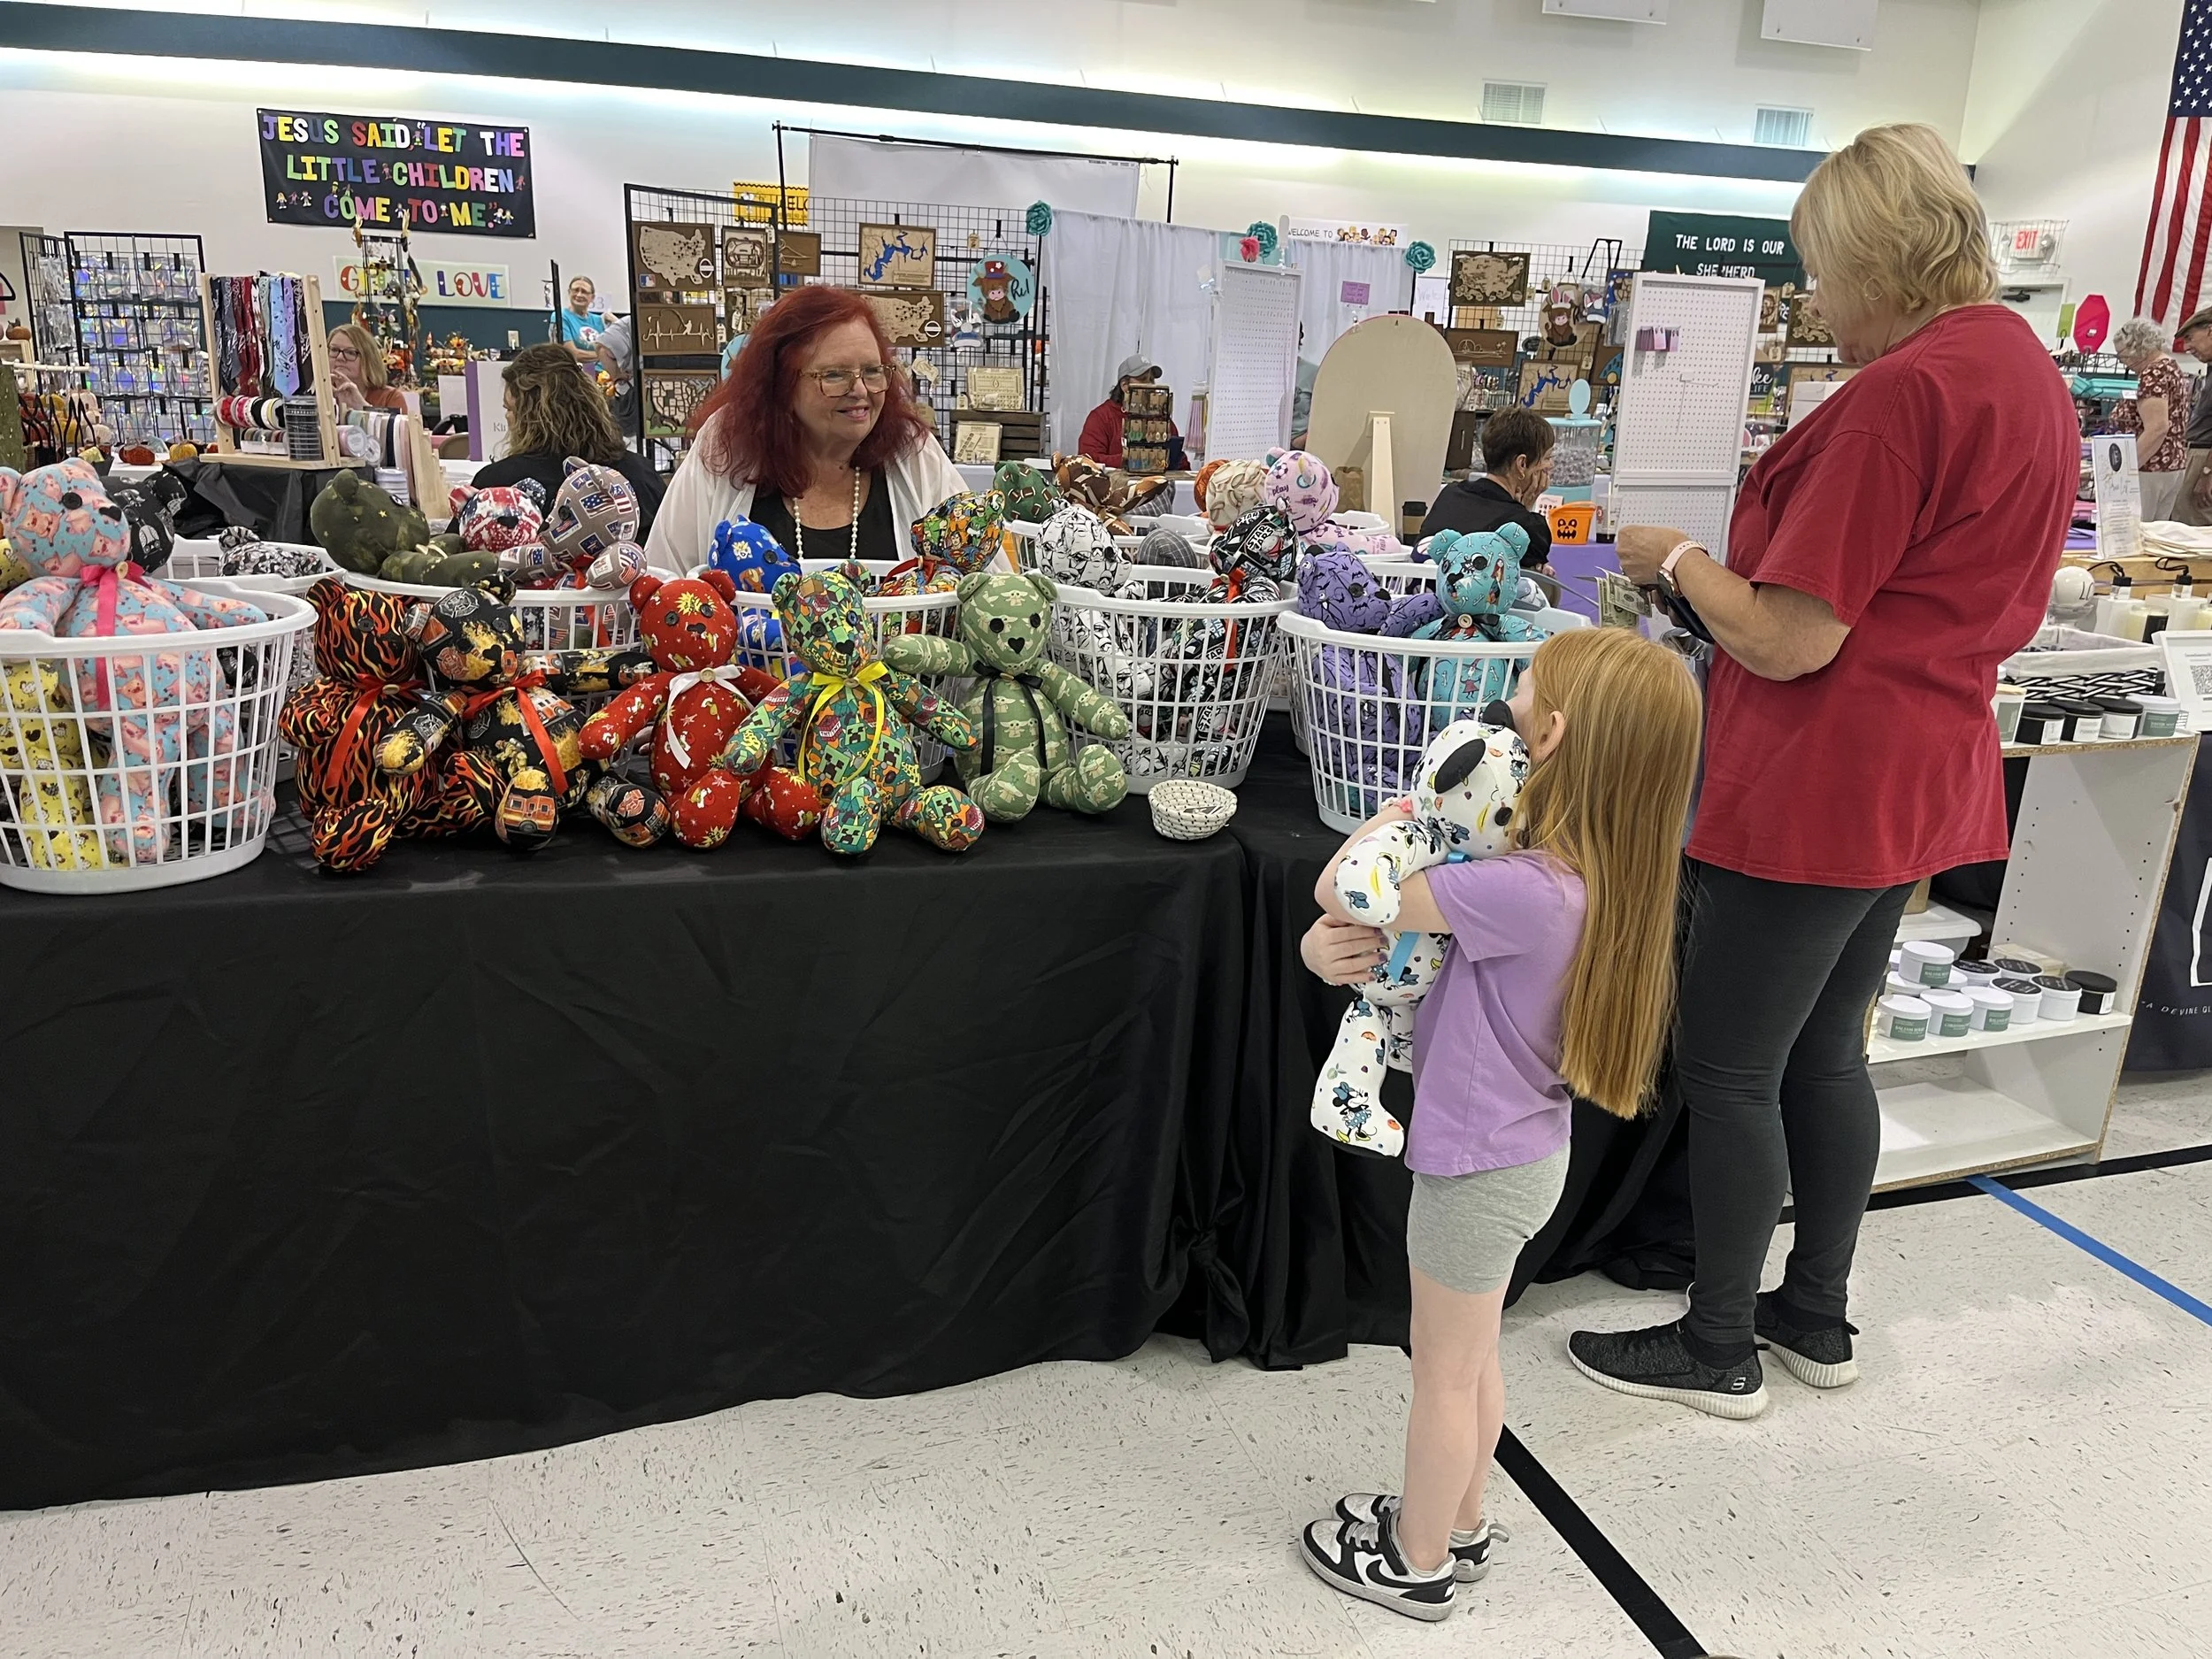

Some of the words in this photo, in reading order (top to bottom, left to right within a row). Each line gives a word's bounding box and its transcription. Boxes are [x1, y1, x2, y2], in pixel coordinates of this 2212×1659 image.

[262, 115, 339, 145] JESUS
[351, 121, 414, 152] SAID,
[480, 131, 525, 157] THE
[287, 154, 380, 184] LITTLE
[392, 162, 514, 193] CHILDREN
[323, 193, 391, 223] COME
[408, 198, 438, 224] TO
[1324, 230, 1333, 239] TO
[1676, 234, 1699, 250] THE
[1705, 237, 1736, 252] LORD
[1743, 238, 1755, 252] IS
[1762, 241, 1785, 256] OUR
[2016, 230, 2039, 250] EXIT
[436, 270, 505, 300] LOVE
[1271, 484, 1289, 495] play
[1246, 525, 1267, 549] STAR
[2161, 1006, 2198, 1016] DEVINE
